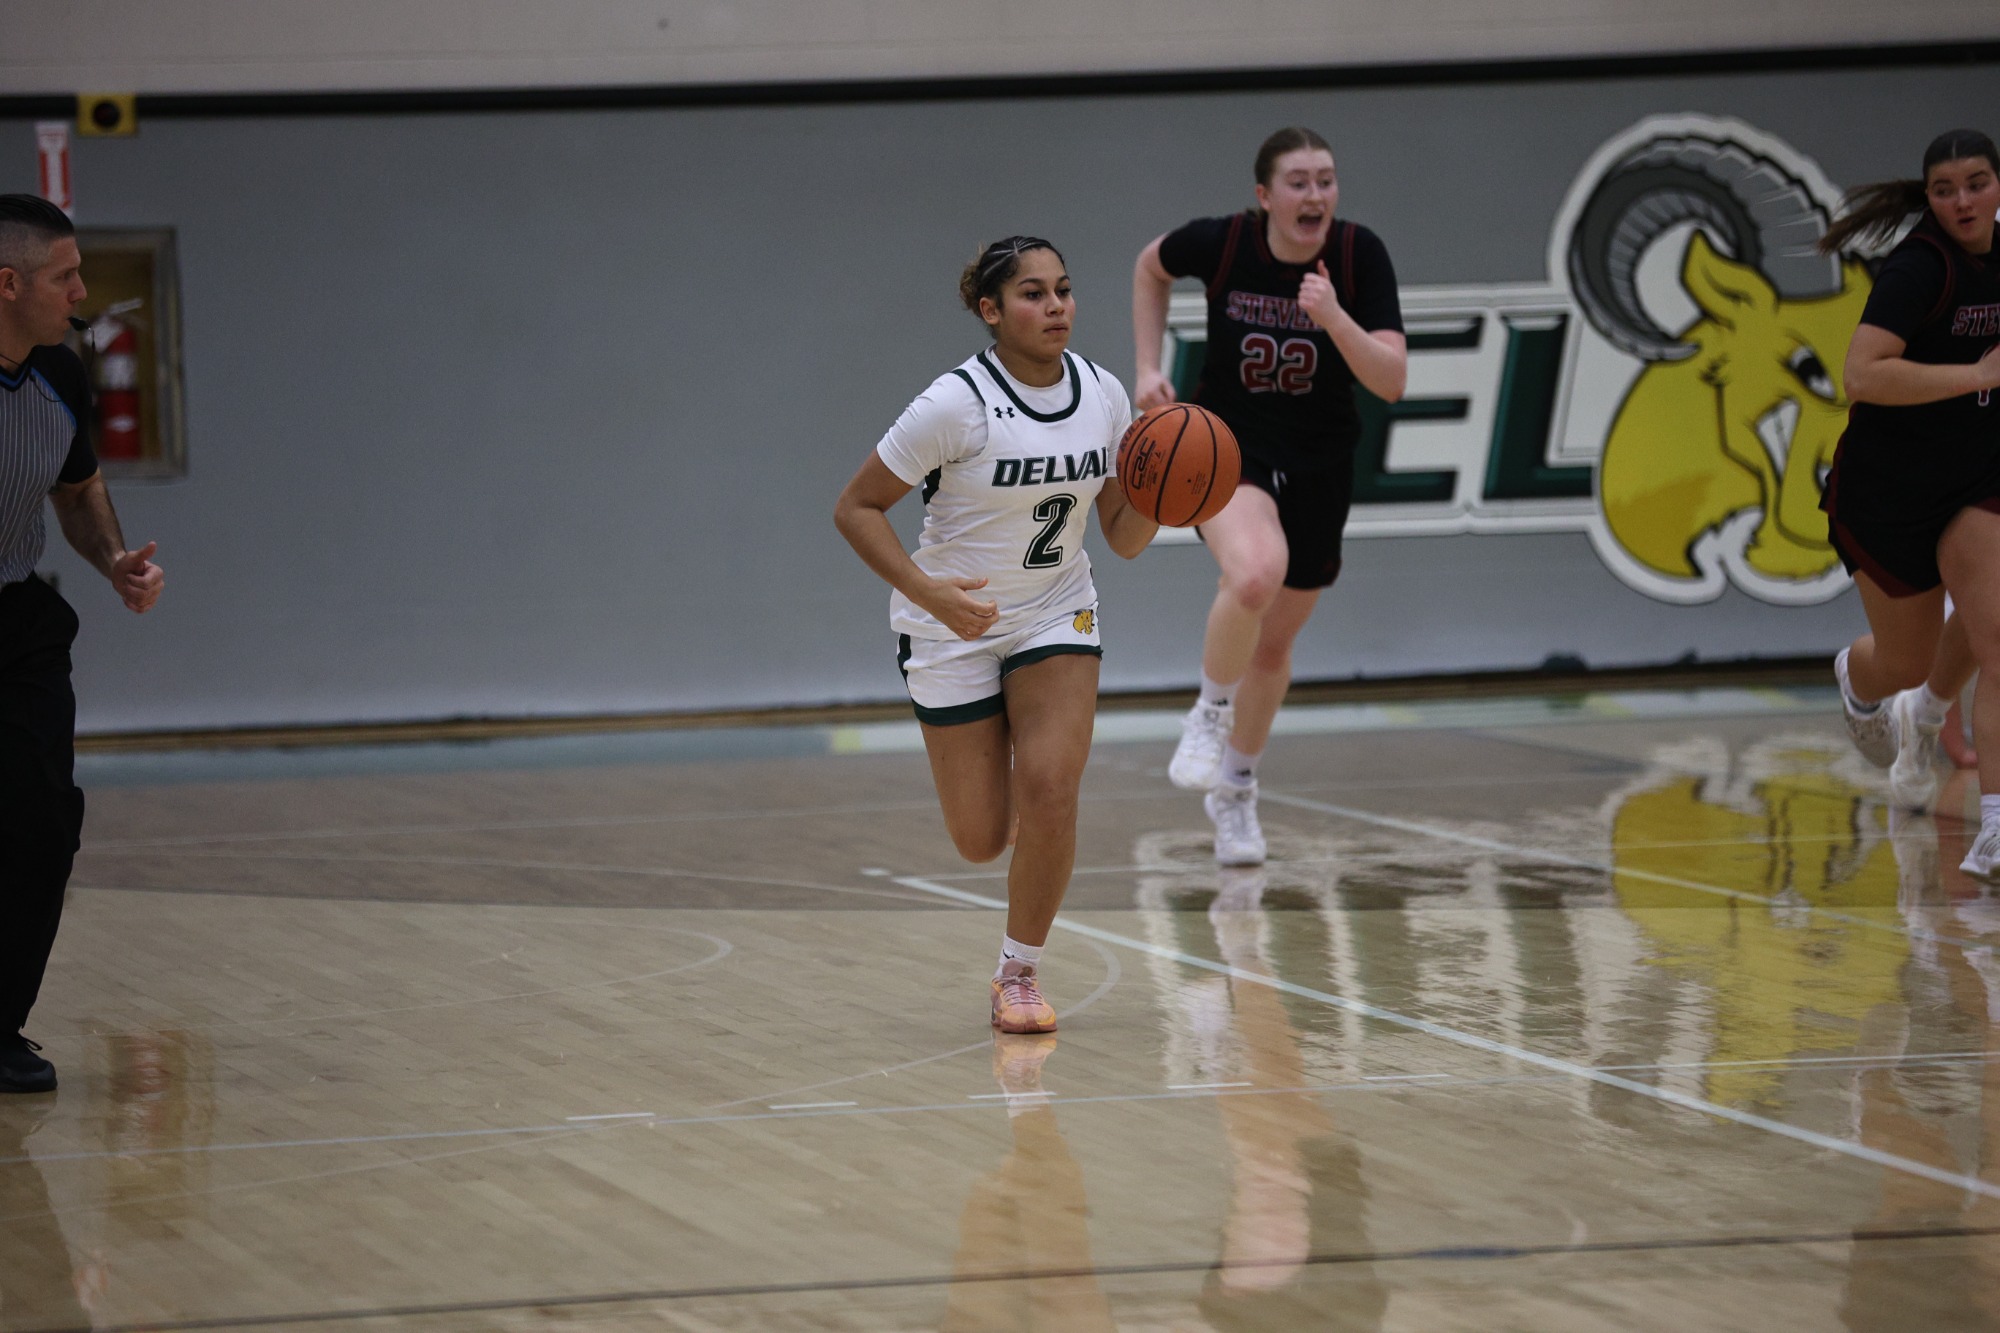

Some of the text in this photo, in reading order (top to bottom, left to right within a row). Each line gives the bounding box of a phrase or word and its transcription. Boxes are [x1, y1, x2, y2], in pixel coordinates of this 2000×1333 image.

[1226, 290, 1325, 332] STEVE
[1951, 304, 2000, 337] STE
[1239, 332, 1318, 396] 22
[1023, 492, 1078, 569] 2
